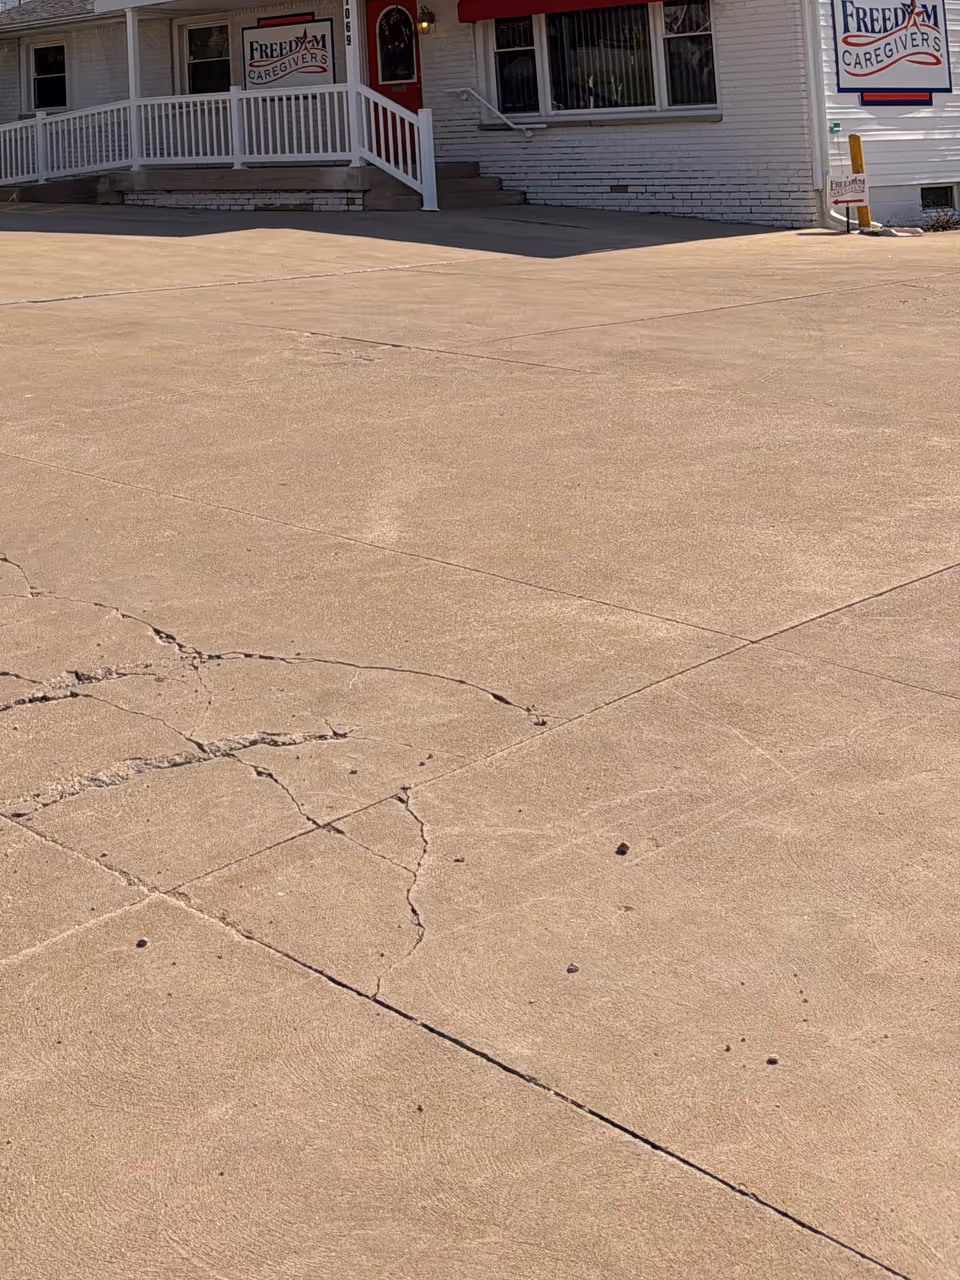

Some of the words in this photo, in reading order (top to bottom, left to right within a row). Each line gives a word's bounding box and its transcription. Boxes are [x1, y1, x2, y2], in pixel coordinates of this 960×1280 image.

[248, 27, 328, 61] FREEDM
[842, 32, 941, 69] CAREGIVERS
[248, 53, 329, 81] CAREGIVERS
[830, 176, 865, 190] FREEM
